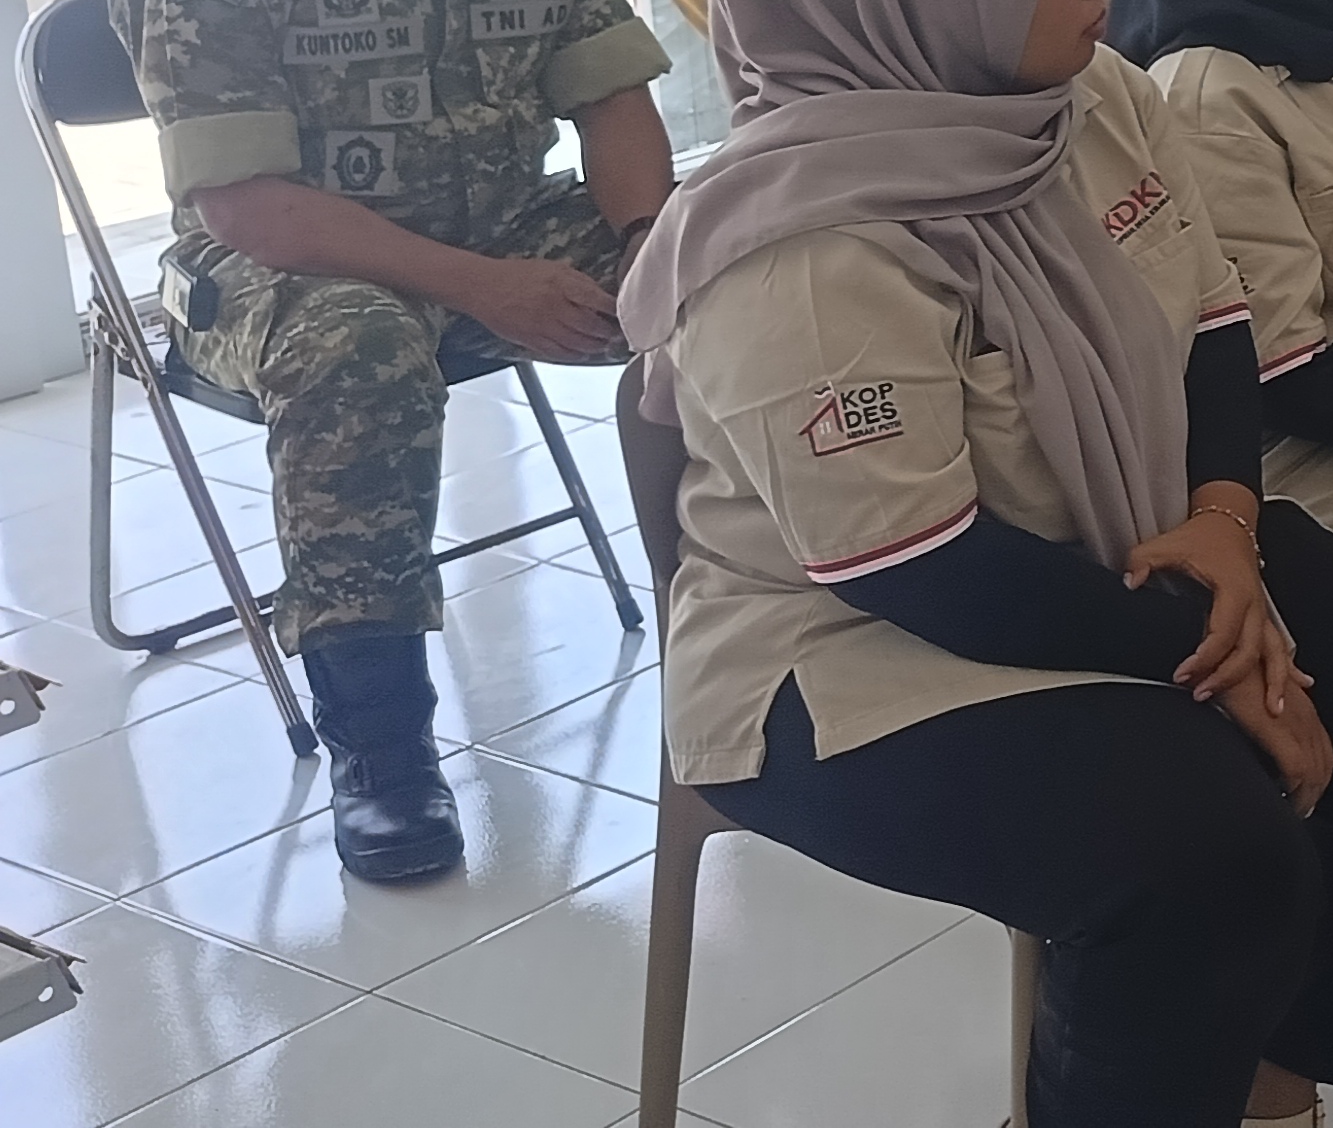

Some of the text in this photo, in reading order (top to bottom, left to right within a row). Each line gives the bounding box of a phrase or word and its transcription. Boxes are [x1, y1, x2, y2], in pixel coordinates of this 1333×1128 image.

[481, 4, 568, 32] TNI AD
[296, 29, 377, 56] KUNTOKO
[840, 383, 893, 410] KOP
[844, 401, 898, 429] DES
